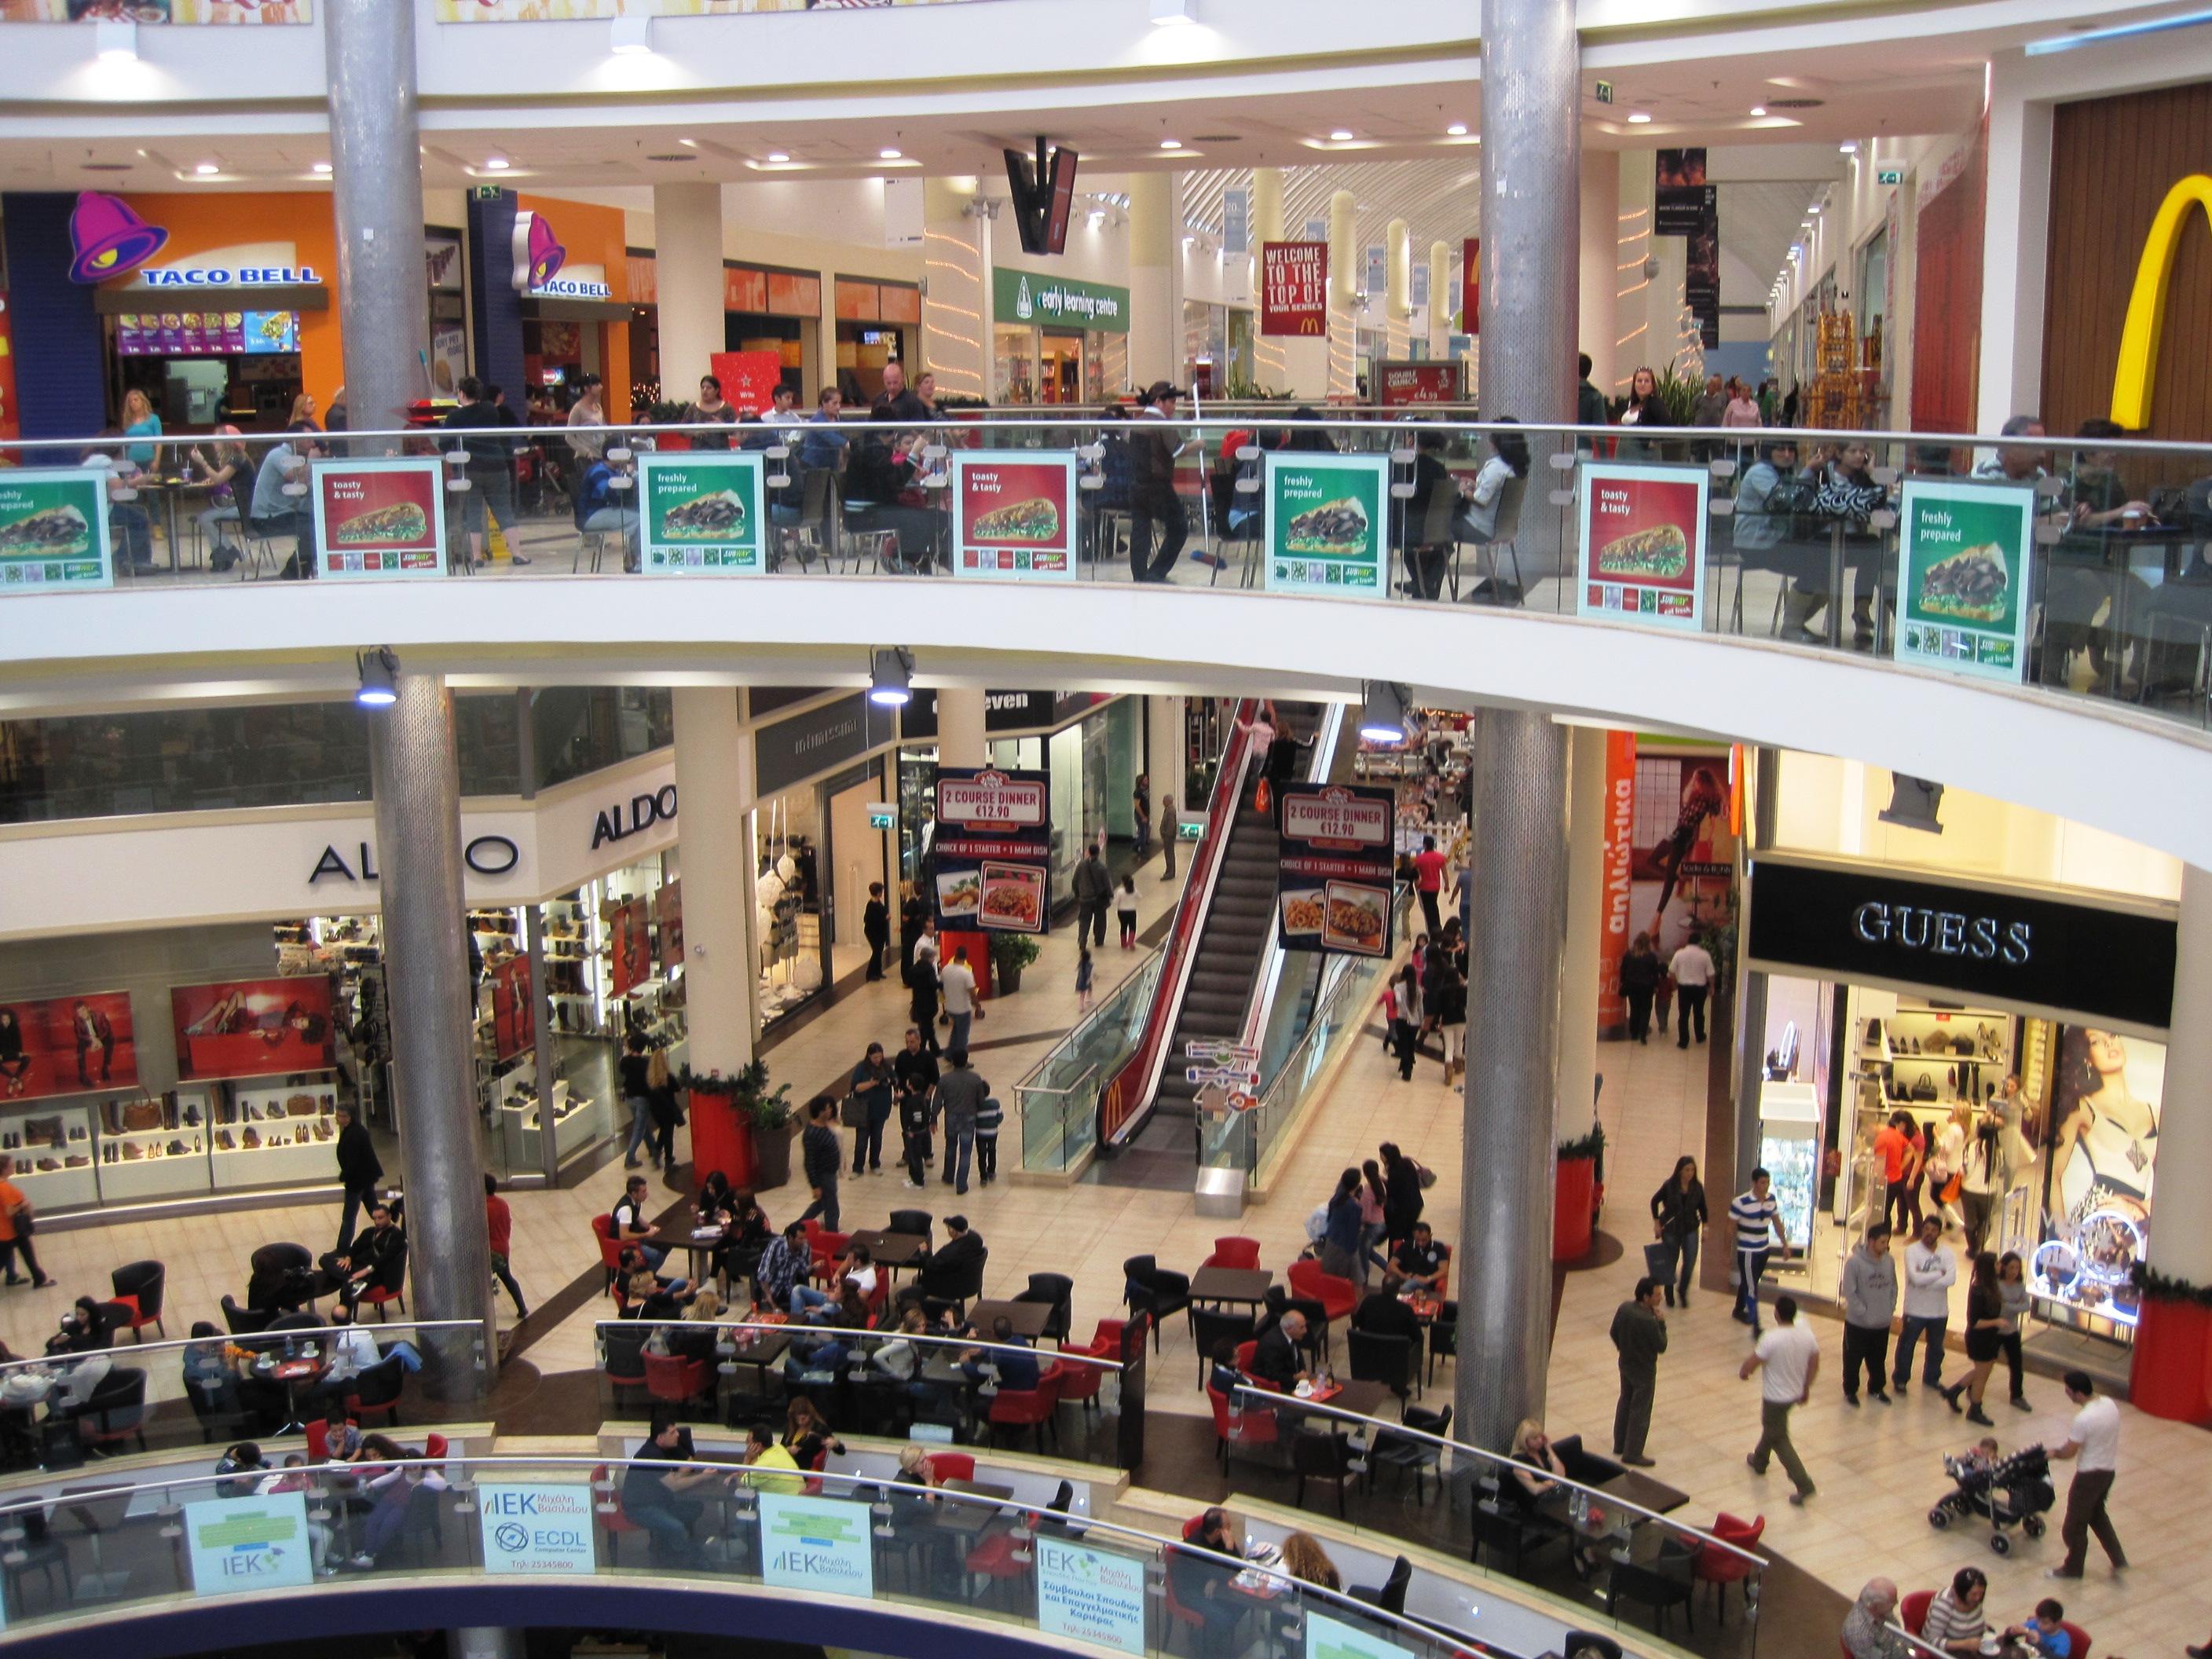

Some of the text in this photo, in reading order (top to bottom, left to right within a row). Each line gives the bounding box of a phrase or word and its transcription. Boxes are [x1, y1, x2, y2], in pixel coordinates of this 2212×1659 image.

[1266, 247, 1320, 264] WELCOME
[141, 267, 321, 286] TACO BELL
[1266, 262, 1320, 284] TO THE
[544, 280, 611, 296] TACO BELL
[1268, 283, 1321, 304] TOP OF
[1042, 285, 1118, 320] early learning centre
[1269, 302, 1322, 313] YOUR SENSES
[657, 473, 687, 483] freshly
[972, 472, 998, 482] toasty
[1284, 475, 1313, 489] freshly
[333, 481, 361, 490] toasty
[658, 484, 697, 494] prepared
[972, 482, 1002, 493] & tasty
[342, 491, 365, 500] tasty
[1284, 488, 1322, 500] prepared
[1601, 489, 1628, 502] toasty
[1600, 501, 1630, 515] & tasty
[1921, 510, 1952, 528] freshly
[1921, 529, 1961, 543] prepared
[1035, 553, 1061, 562] SUBWAY
[1345, 566, 1372, 577] SUBWAY
[1660, 595, 1688, 606] SUBWAY
[1980, 639, 2009, 653] SUBWAY
[945, 790, 1036, 806] 2 COURSE DINNER
[591, 784, 678, 849] ALDO
[976, 806, 1009, 818] €12.90
[1291, 805, 1381, 824] 2 COURSE DINNER
[1320, 824, 1354, 837] €12.90
[936, 843, 957, 852] CHOICE
[959, 844, 967, 852] OF
[974, 844, 1001, 854] STARTER
[1014, 845, 1031, 855] MAIN
[1033, 846, 1048, 855] DISH
[309, 835, 519, 883] ALO
[1280, 859, 1302, 870] CHOICE
[1304, 861, 1312, 870] OF
[1320, 862, 1346, 873] STARTER
[1377, 866, 1392, 877] DISH
[1853, 902, 2031, 964] GUESS
[537, 1494, 574, 1507] Μιχάλη
[535, 1531, 586, 1546] ECDL
[532, 1560, 573, 1569] 25345800
[1043, 1580, 1140, 1612] Σύμβουλοι Σπουδών
[1045, 1594, 1139, 1624] και Επαγγελματικής
[1070, 1608, 1115, 1628] Καριέρας
